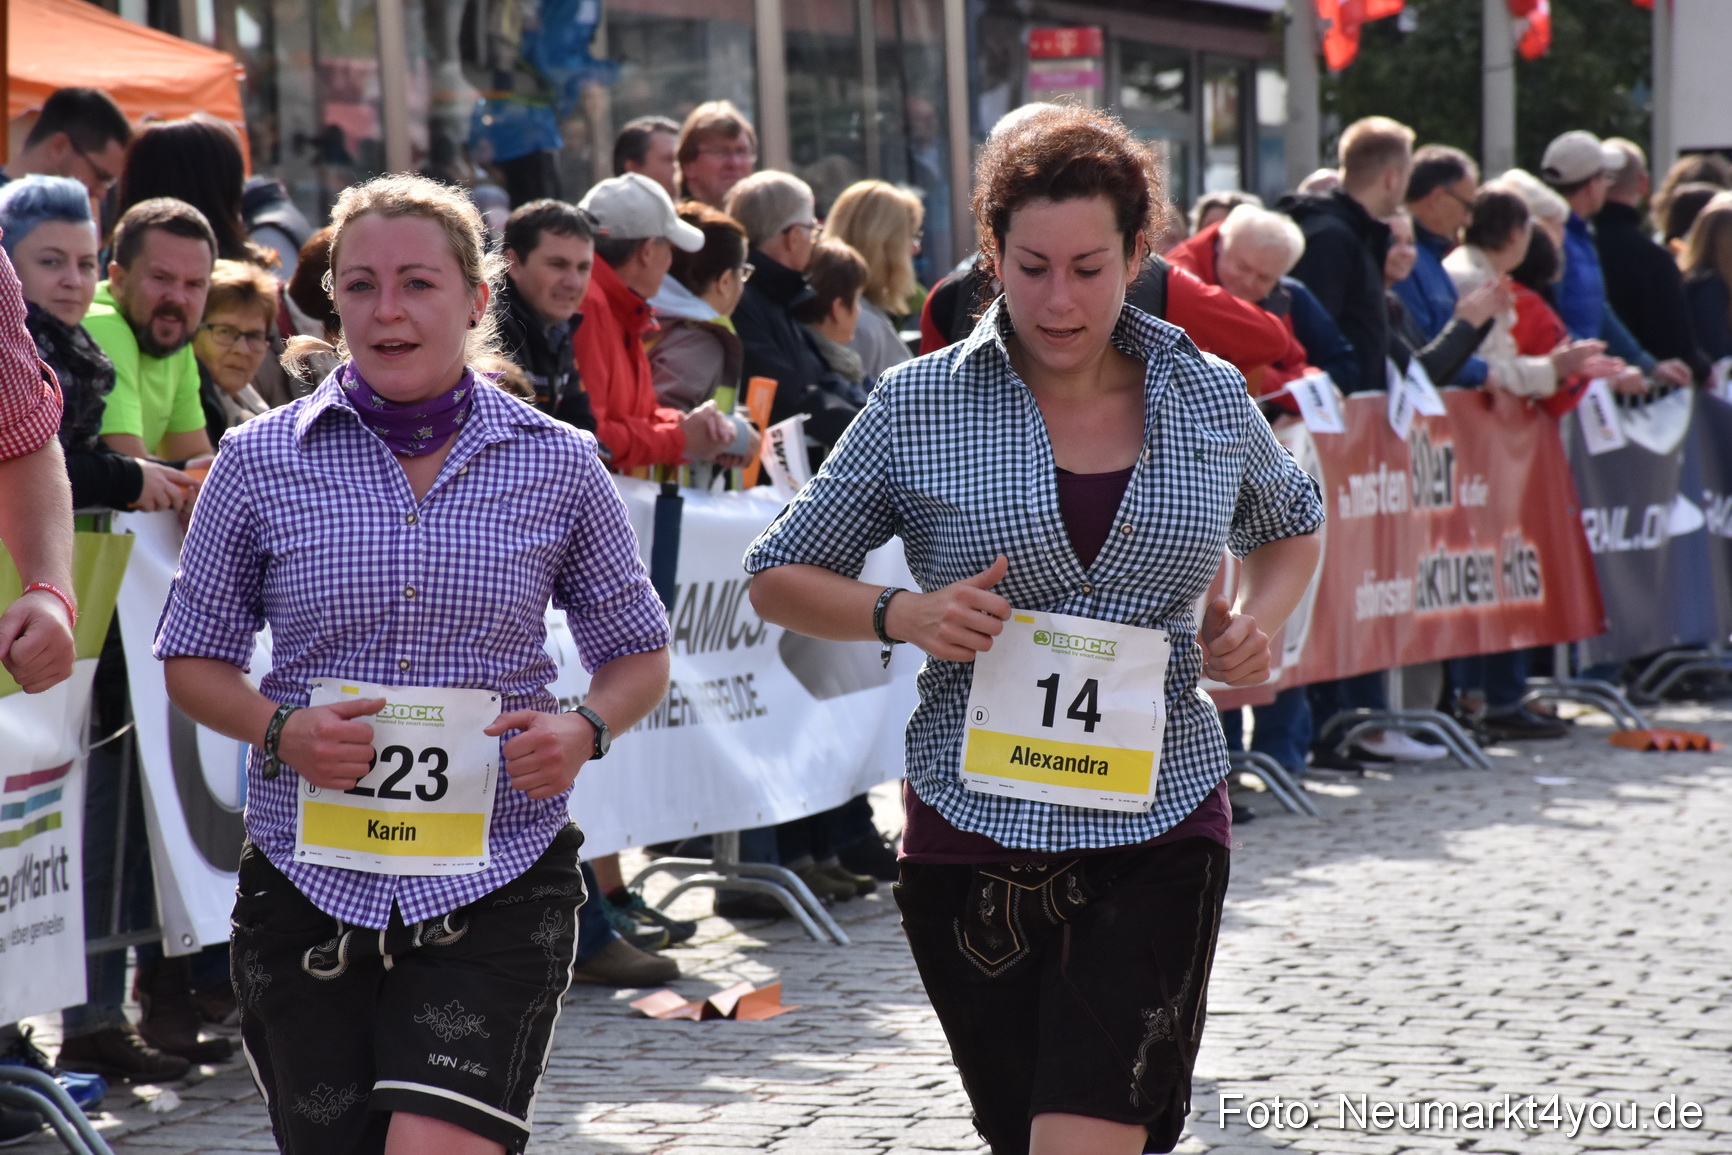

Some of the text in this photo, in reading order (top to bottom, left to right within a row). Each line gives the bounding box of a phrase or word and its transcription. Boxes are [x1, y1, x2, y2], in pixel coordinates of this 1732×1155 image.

[1052, 632, 1117, 656] BOCK
[376, 703, 445, 721] BOCK
[1036, 672, 1101, 734] 14
[976, 711, 983, 721] D
[1009, 745, 1109, 776] Alexandra
[367, 819, 416, 841] Karin
[427, 1053, 458, 1068] ALPIN
